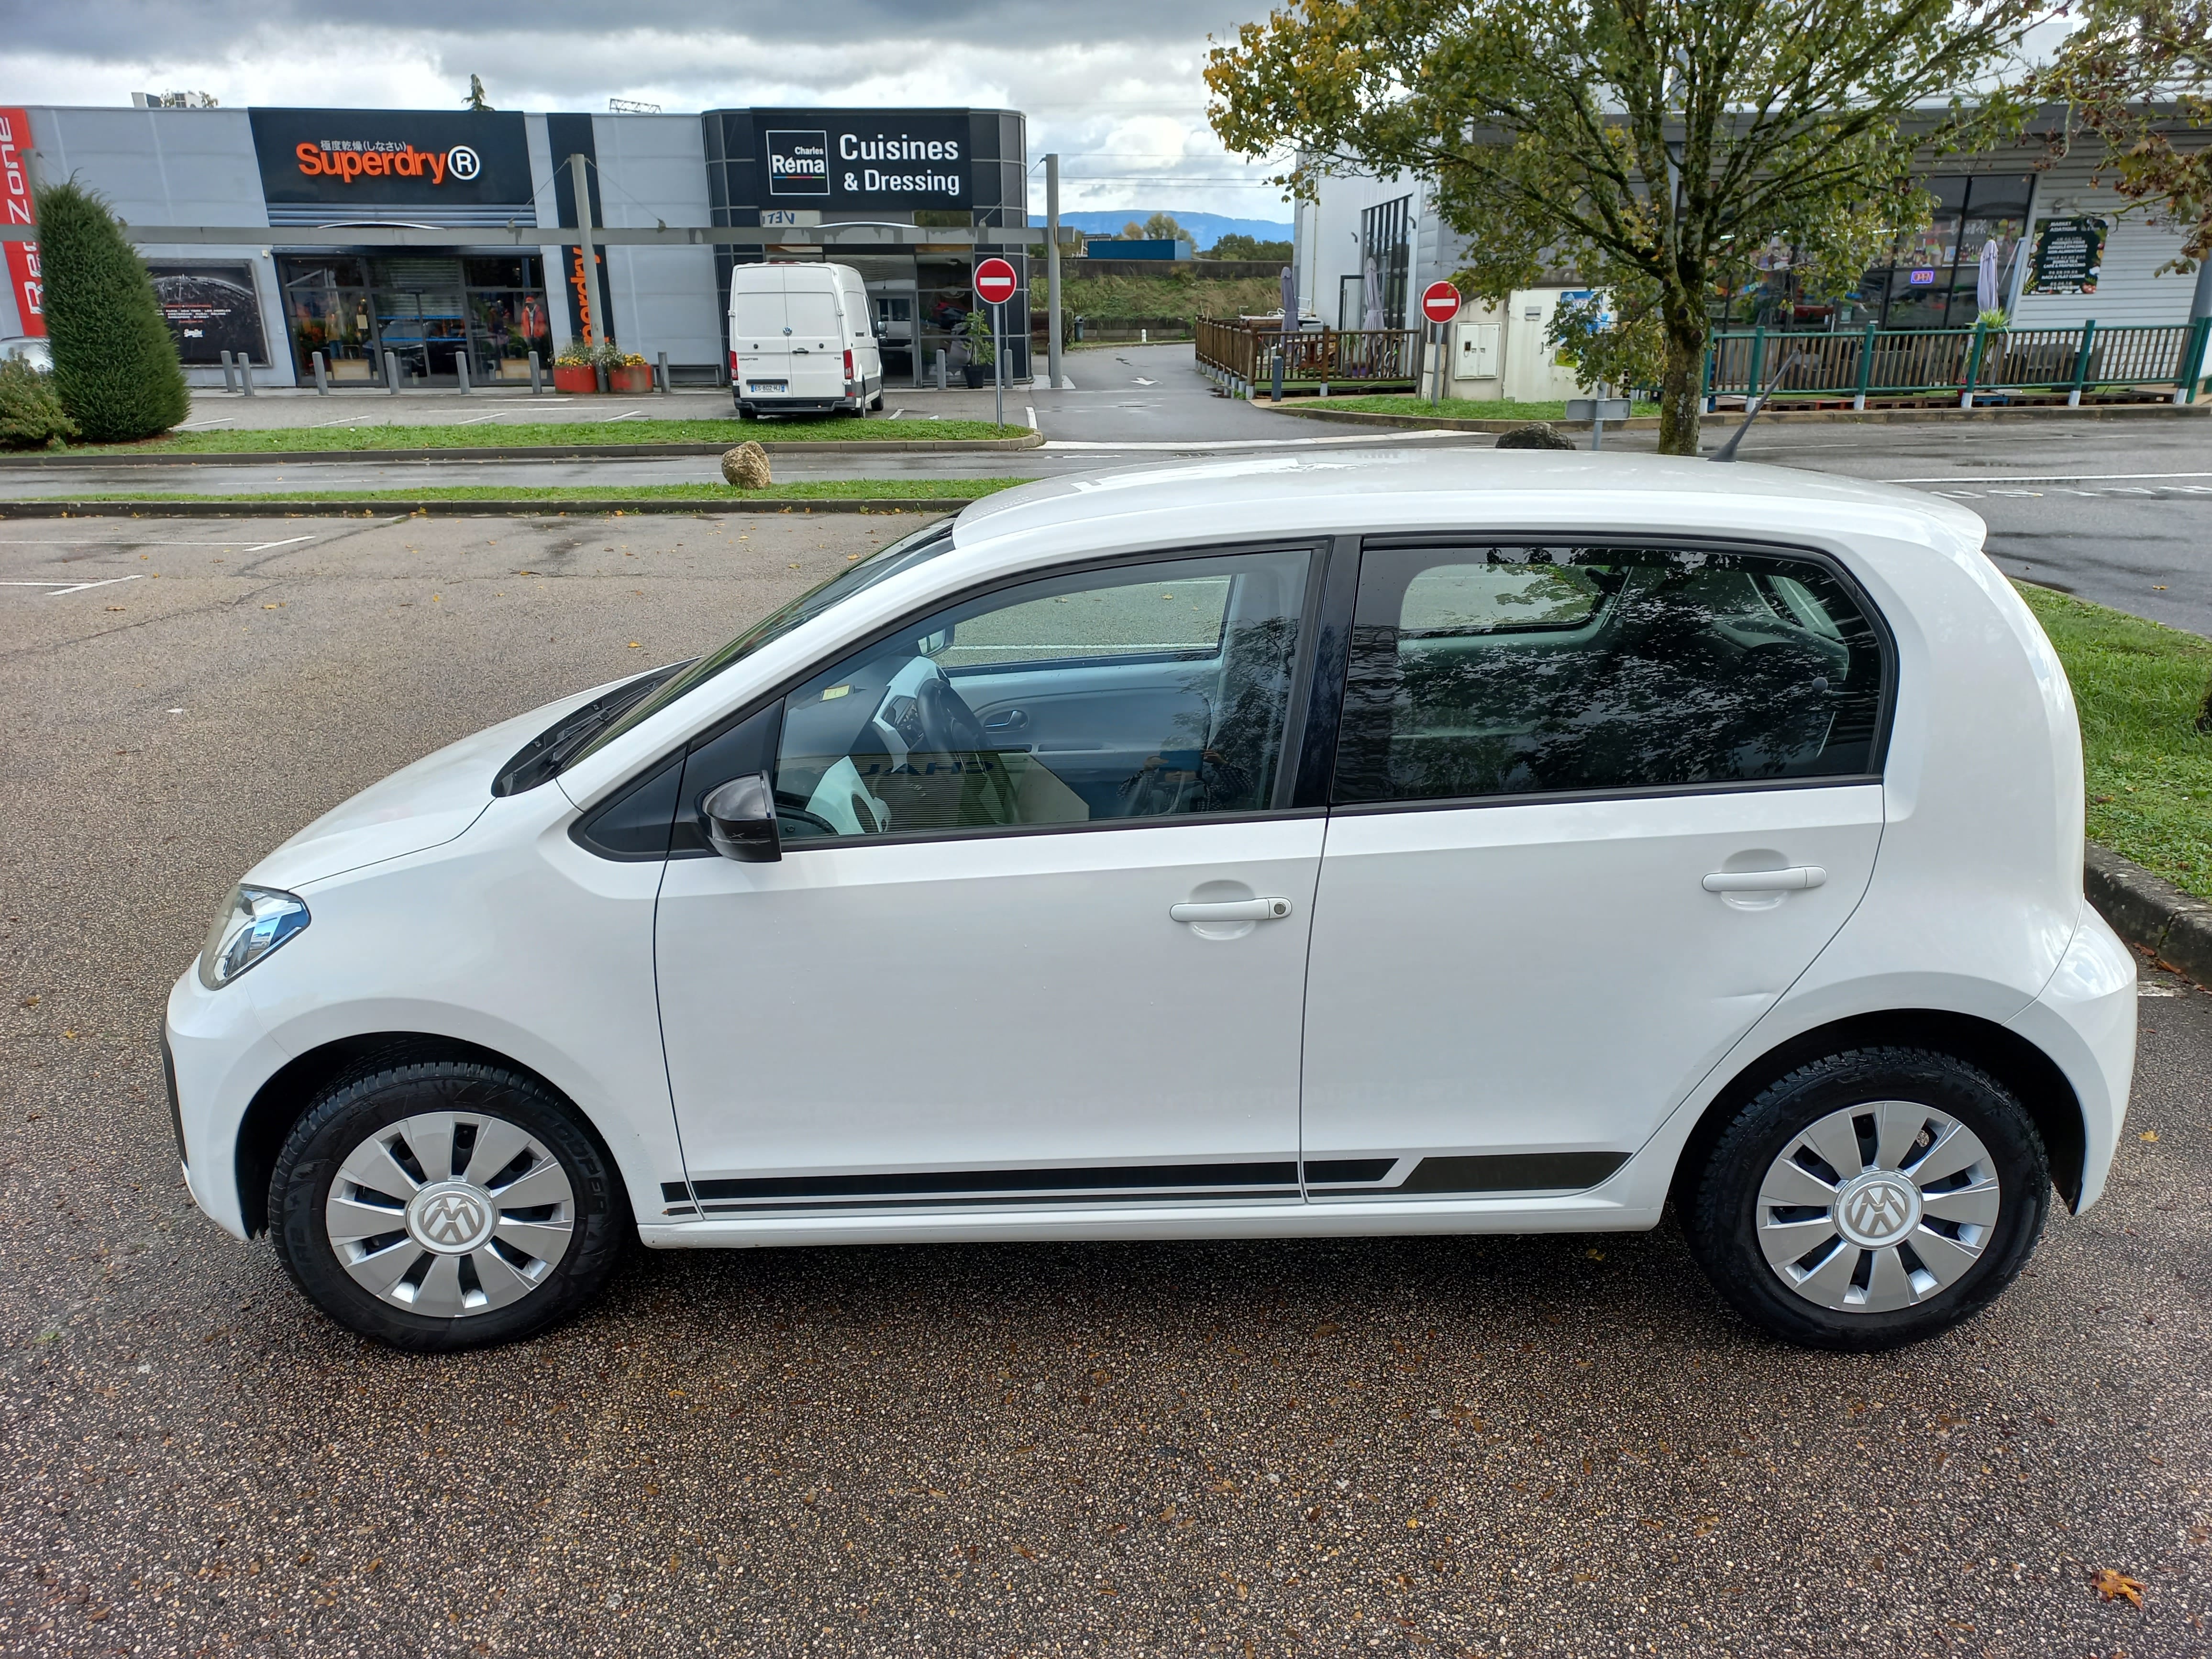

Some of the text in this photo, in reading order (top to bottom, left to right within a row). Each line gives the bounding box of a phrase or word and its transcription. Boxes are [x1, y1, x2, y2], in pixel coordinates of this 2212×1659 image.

[795, 146, 823, 155] Charles
[839, 133, 959, 161] Cuisines
[772, 155, 825, 173] Réma
[843, 169, 959, 196] & Dressing
